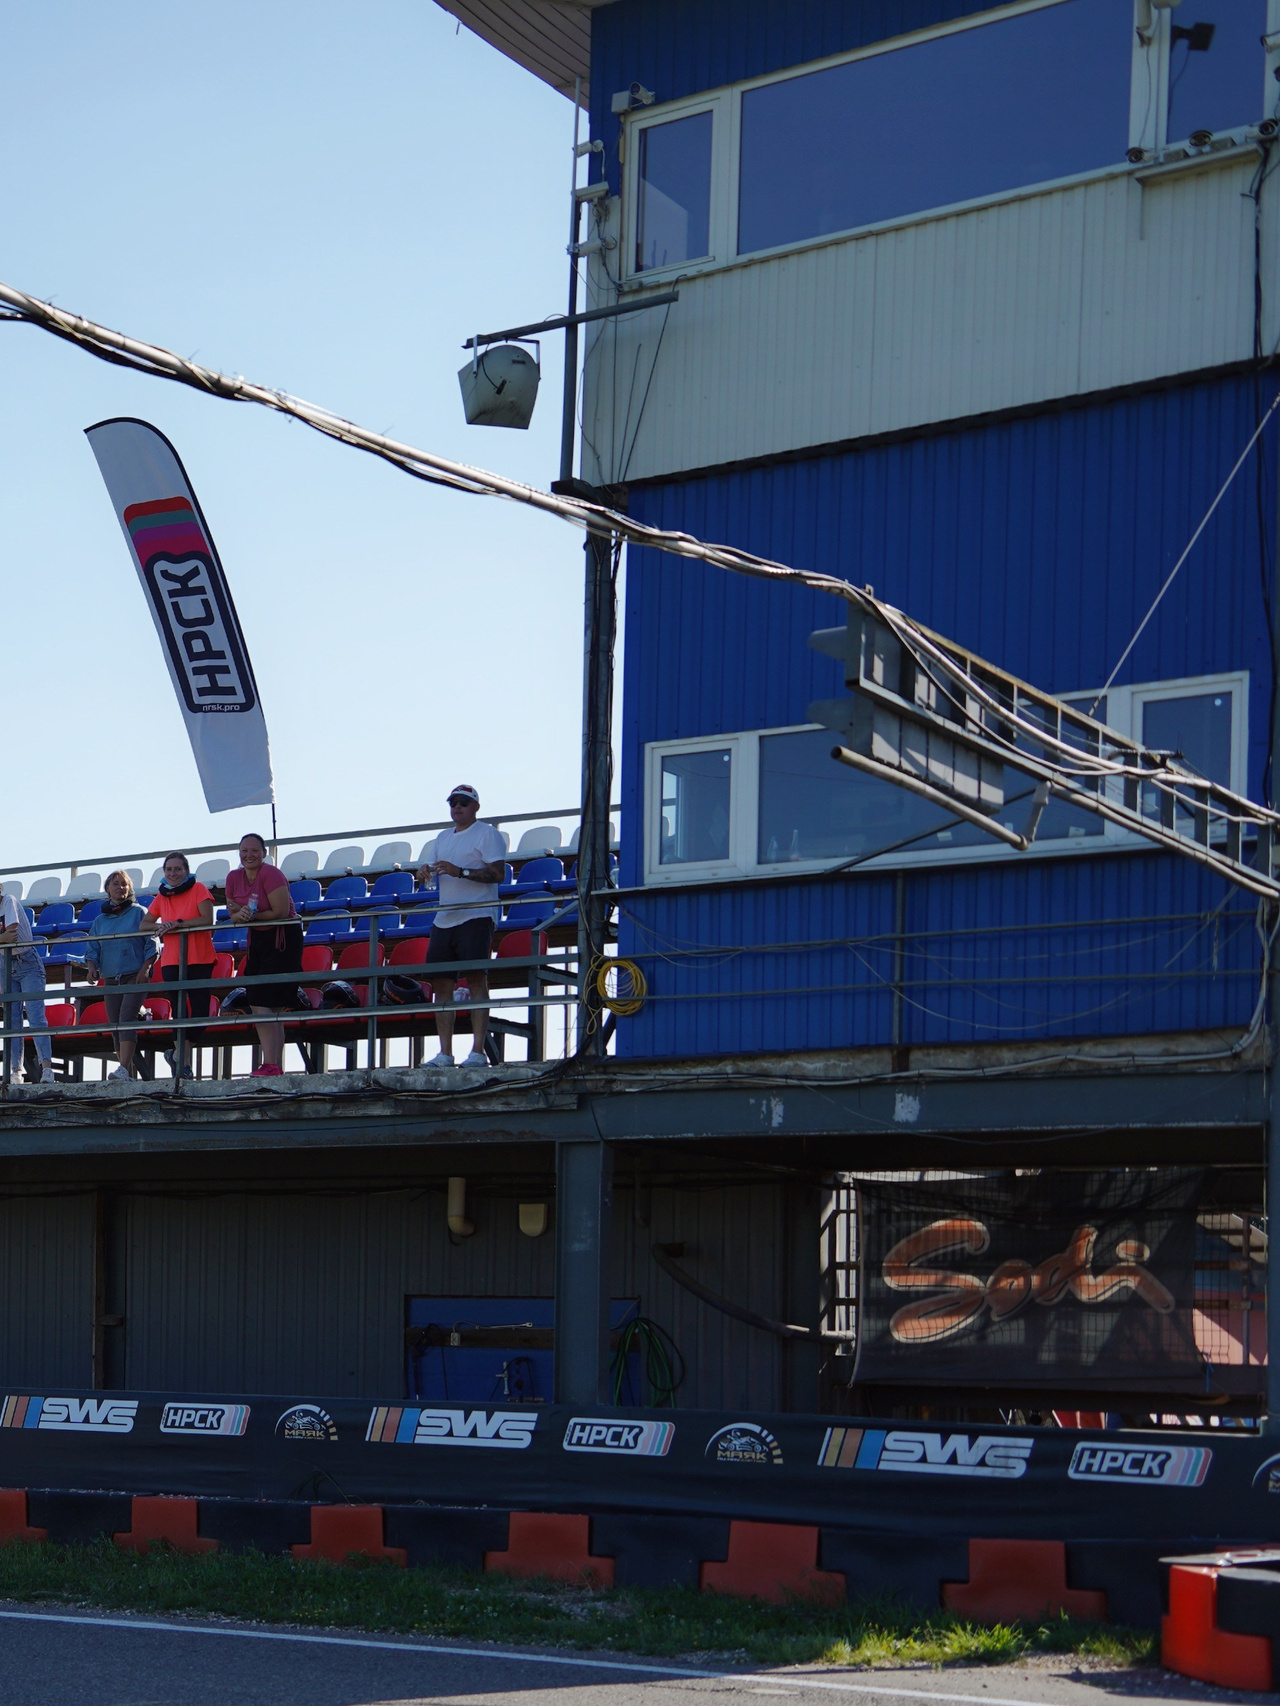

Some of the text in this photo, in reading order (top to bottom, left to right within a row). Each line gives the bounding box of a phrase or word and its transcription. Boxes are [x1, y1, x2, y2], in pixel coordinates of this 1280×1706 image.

[201, 703, 240, 712] nrsk.pro
[38, 1397, 139, 1433] SWS
[414, 1408, 538, 1449] SWS
[877, 1431, 1035, 1478] SWS
